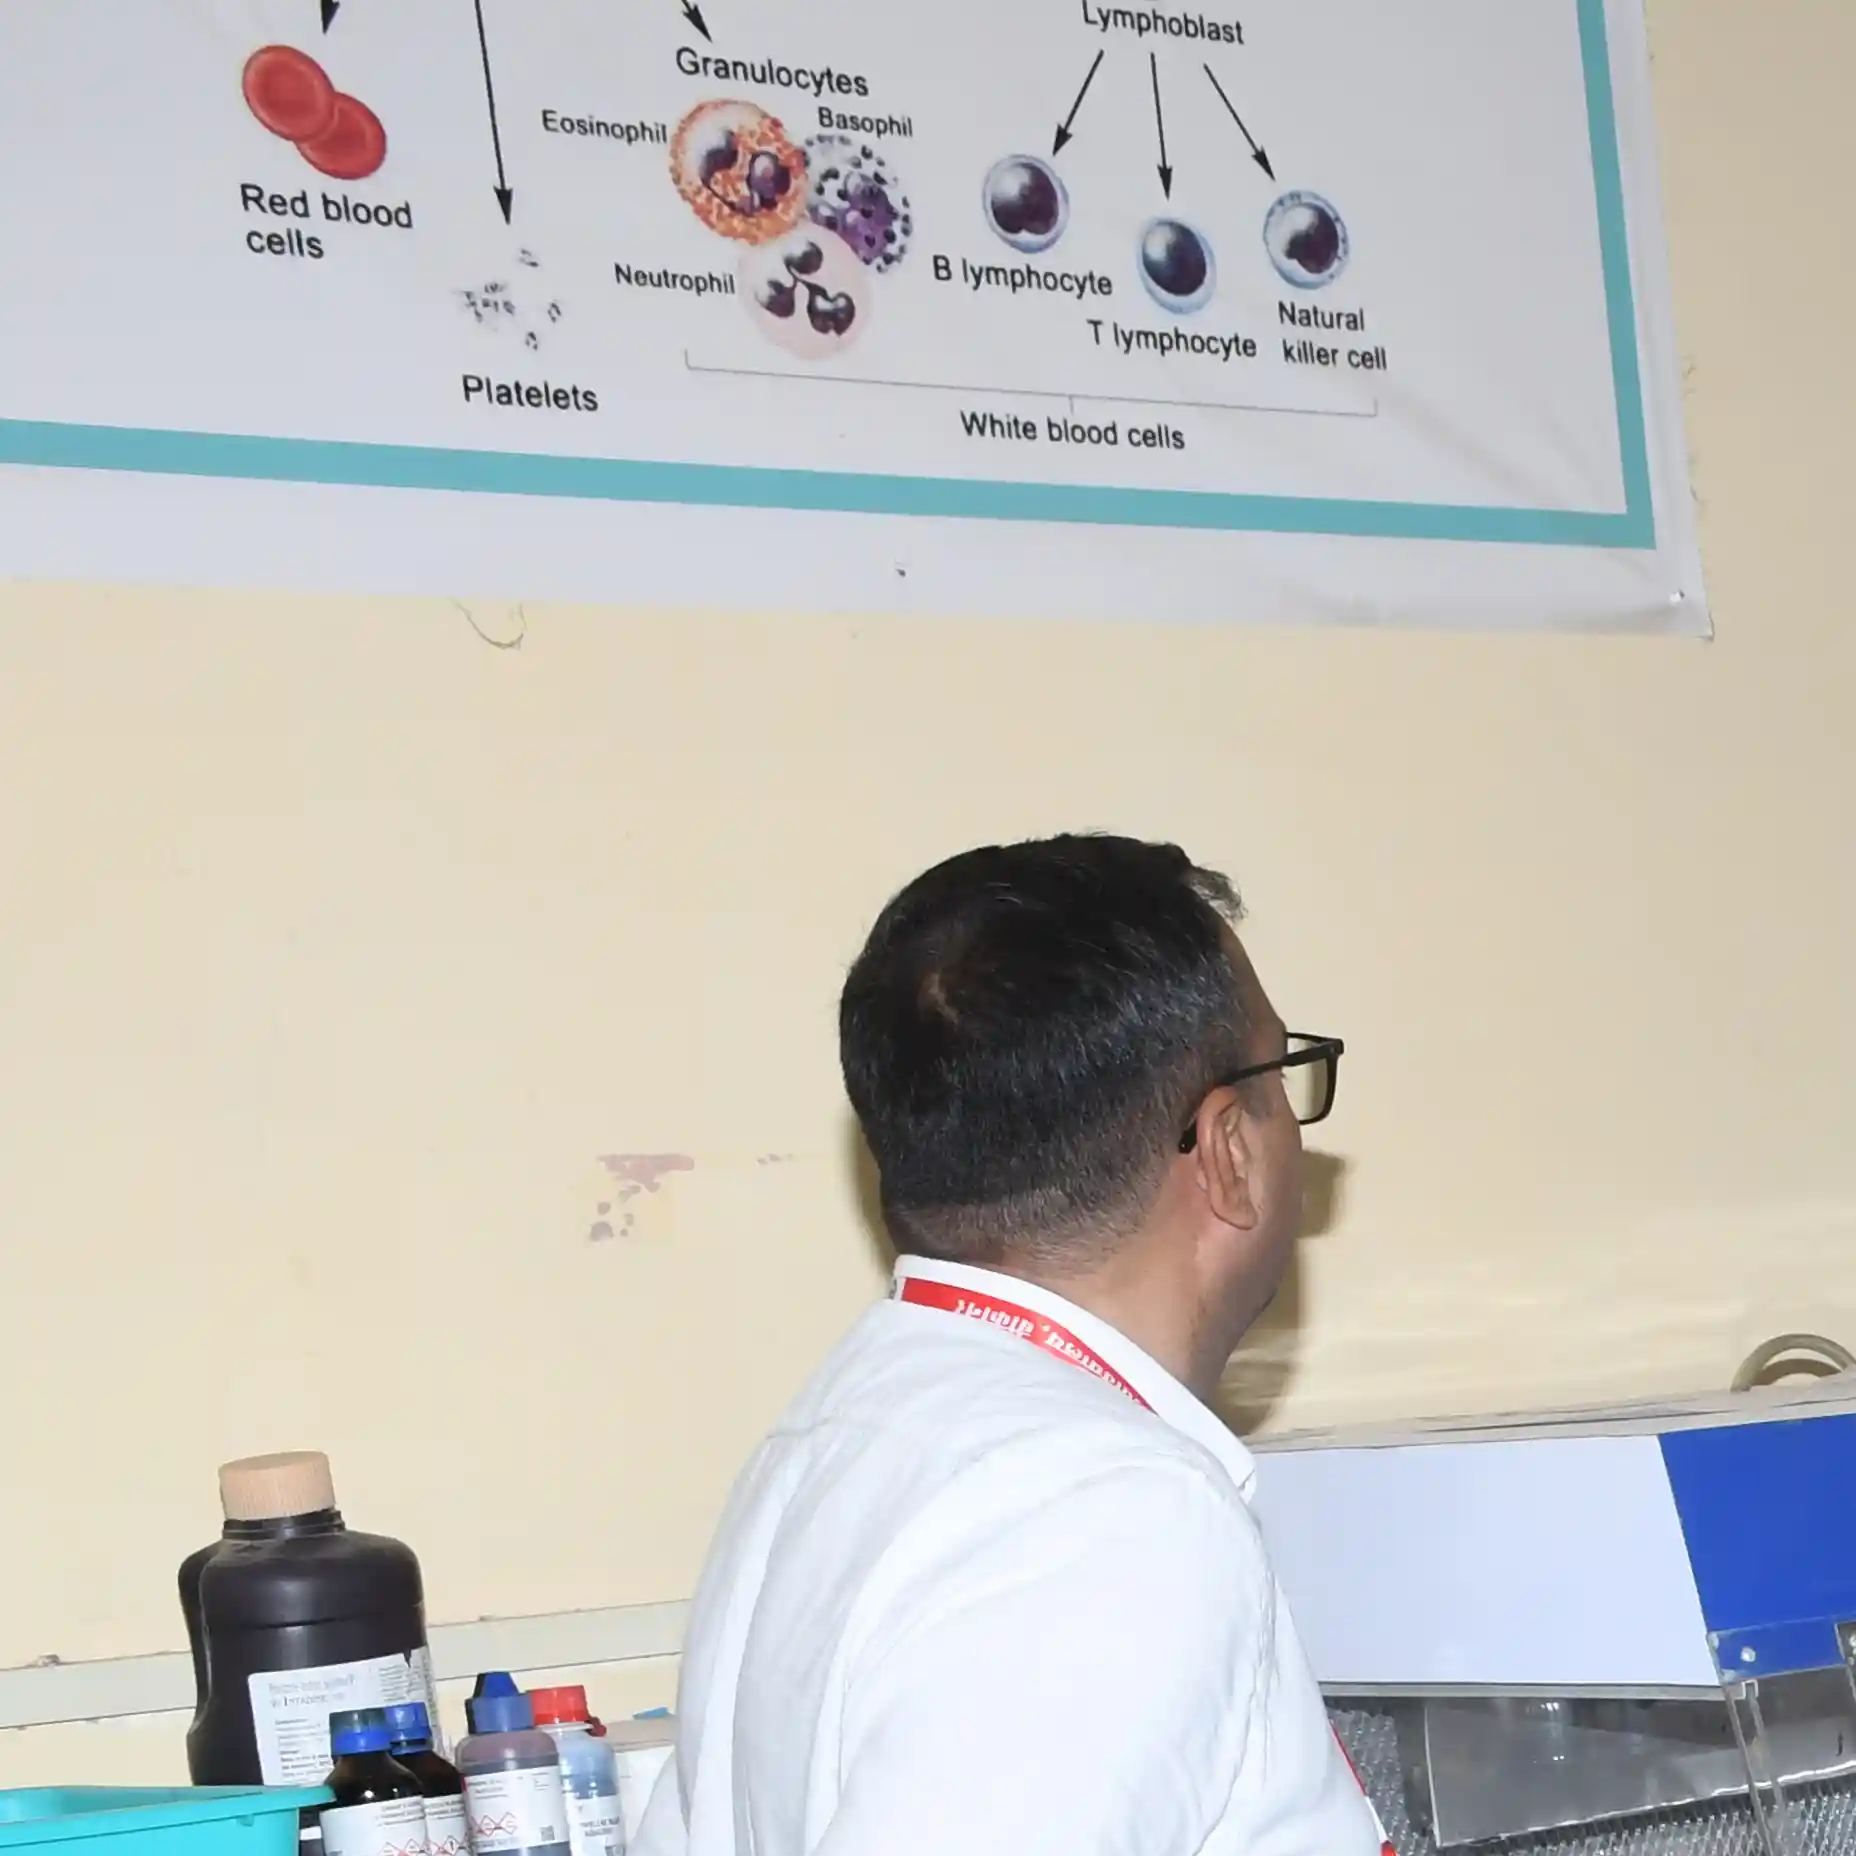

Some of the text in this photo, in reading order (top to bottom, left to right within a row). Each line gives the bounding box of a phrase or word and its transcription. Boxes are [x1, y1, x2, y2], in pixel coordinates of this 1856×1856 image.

[1081, 0, 1245, 45] Lymphoblast
[674, 46, 870, 98] Granulocytes
[540, 108, 668, 147] Eosinophil
[816, 105, 916, 140] Basophil
[240, 183, 413, 230] Red blood
[245, 230, 325, 260] cells
[614, 262, 736, 296] Neutrophil
[932, 254, 1114, 299] B lymphocyte
[1277, 300, 1366, 334] Natural
[1086, 318, 1258, 362] T lymphocyte
[1282, 338, 1388, 372] killer cell
[461, 374, 599, 413] Platelets
[960, 410, 1186, 452] White blood cells
